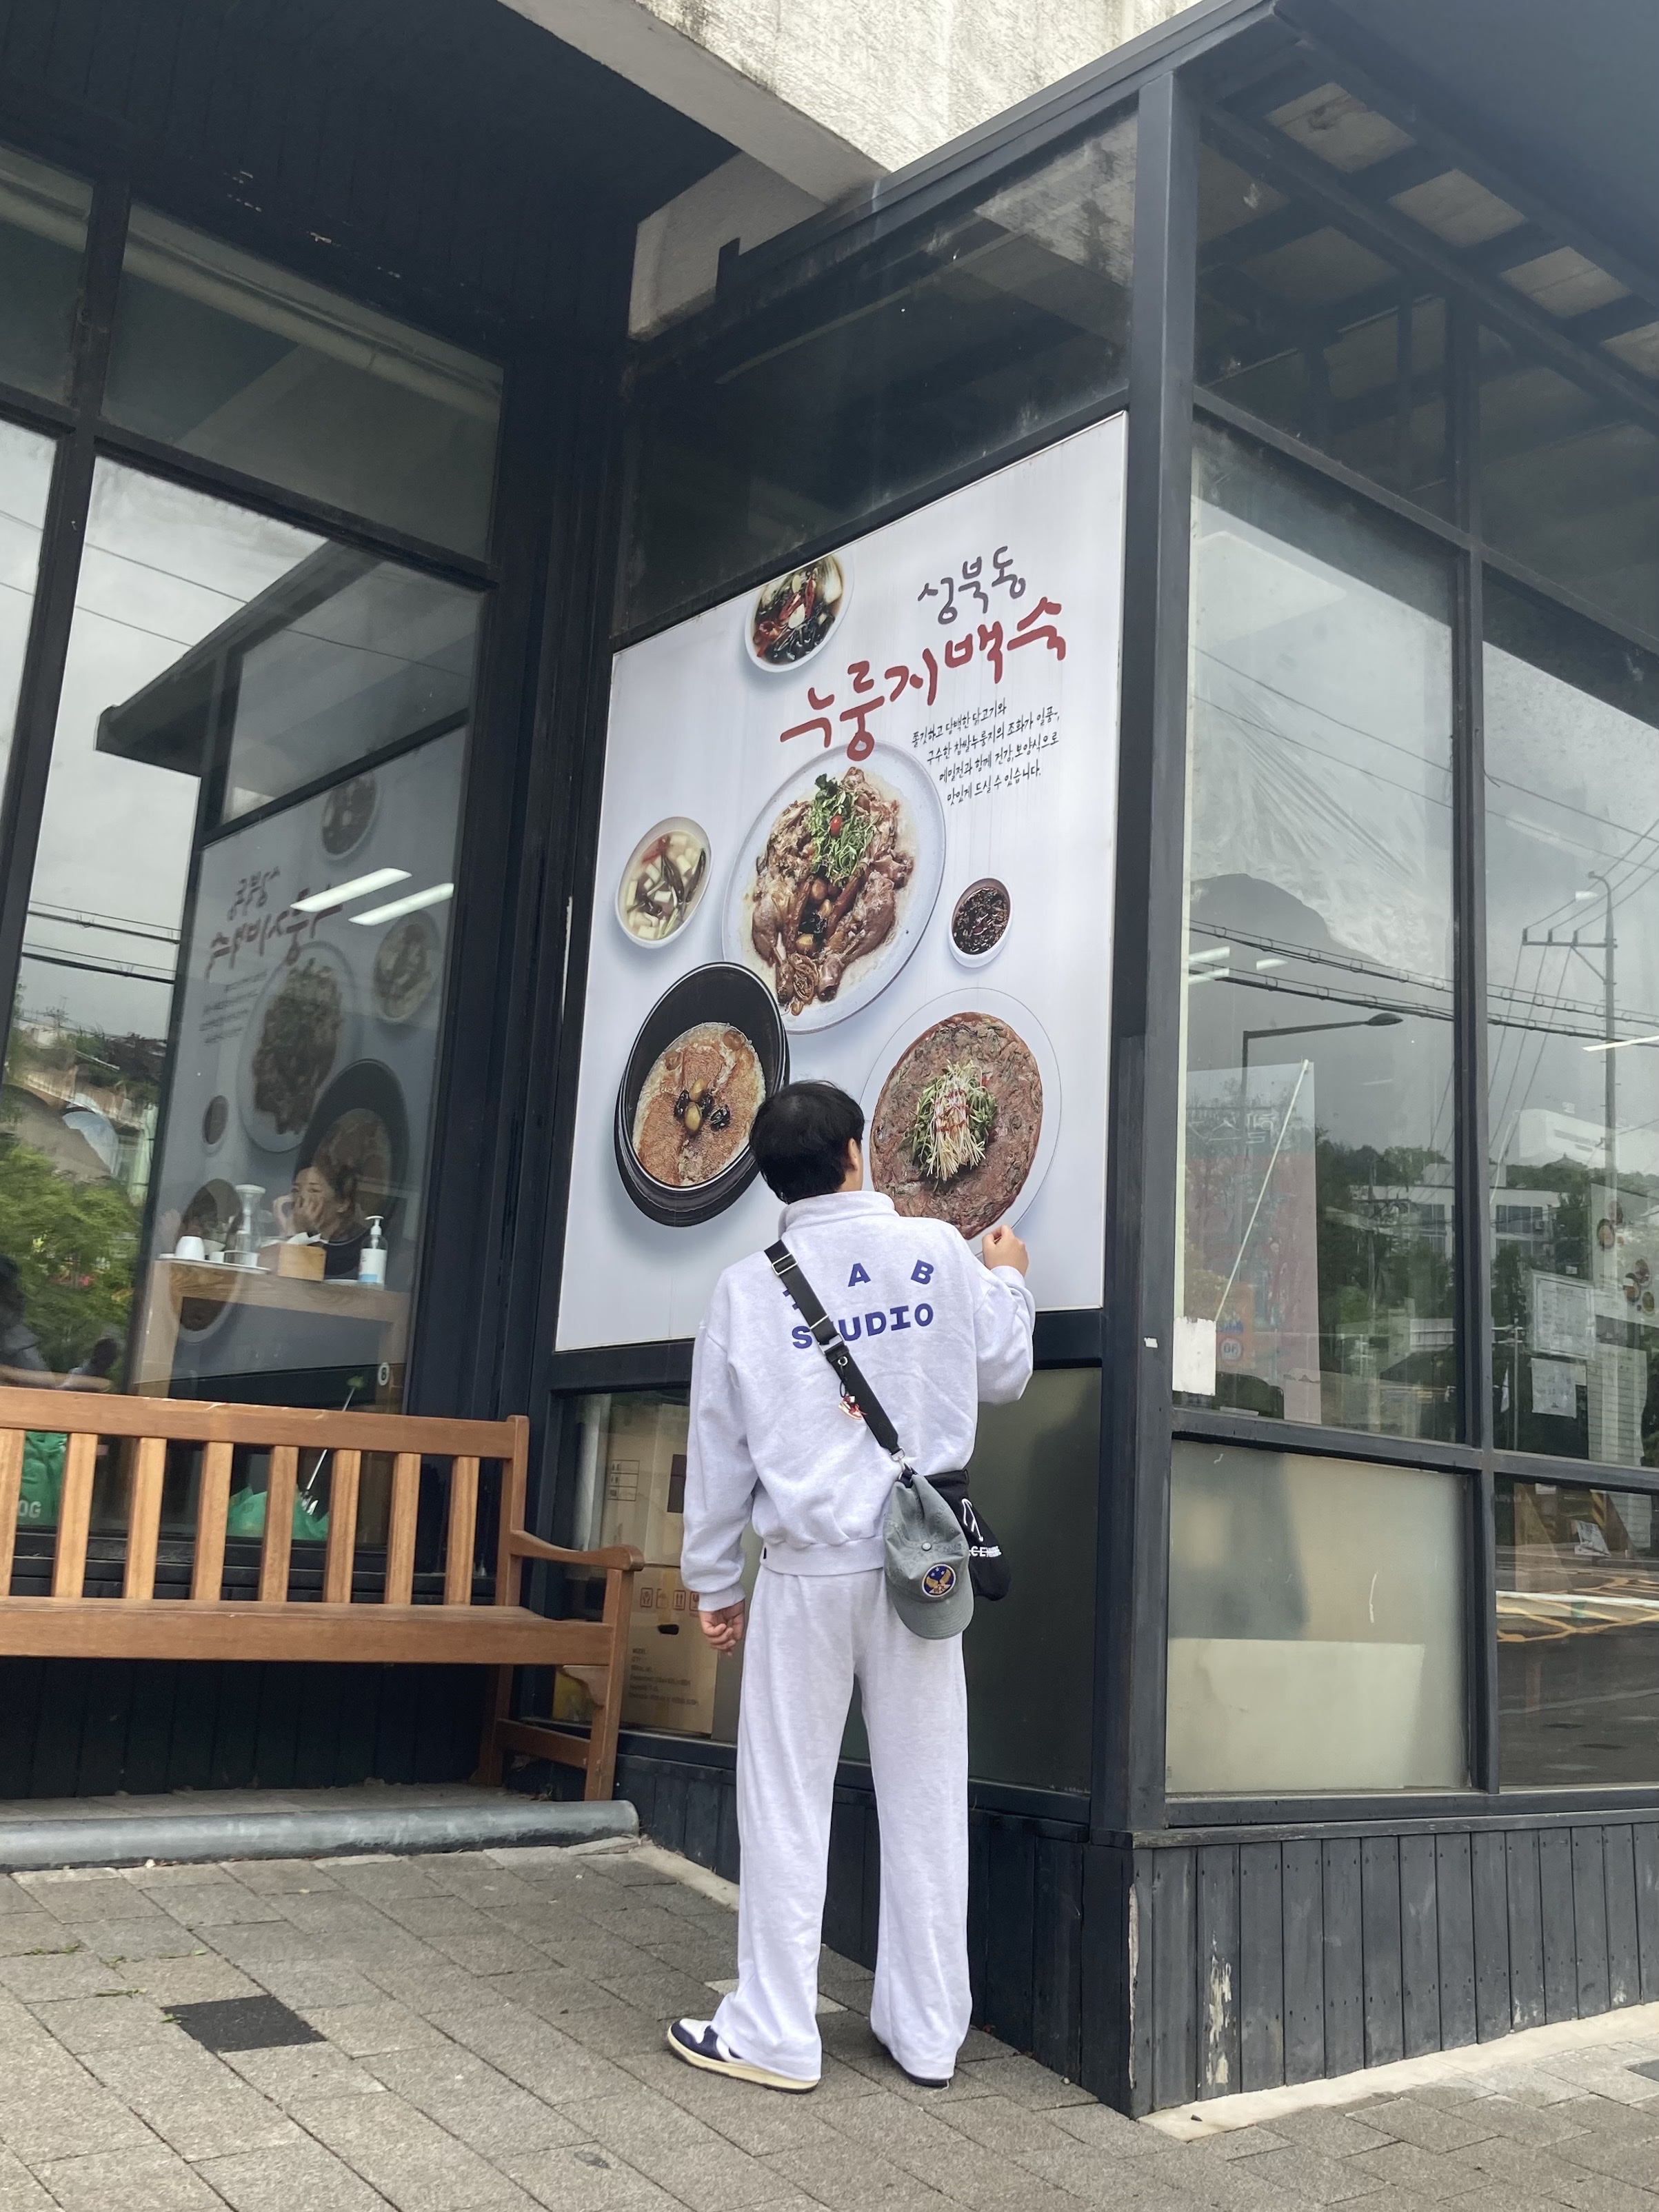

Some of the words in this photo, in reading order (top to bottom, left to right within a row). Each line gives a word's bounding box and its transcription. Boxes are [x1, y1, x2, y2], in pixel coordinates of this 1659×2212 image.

[918, 546, 1025, 624] 성북동
[781, 597, 1066, 762] 누룽지백숙
[927, 741, 952, 765] 구수한
[954, 721, 1005, 756] 찹쌀누룽지의
[1007, 711, 1034, 736] 조화가
[945, 711, 970, 735] 담백한
[972, 697, 1007, 726] 닭고기와
[939, 757, 973, 783] 메밀전과
[975, 750, 992, 772] 함께
[947, 782, 972, 806] 맛있게
[974, 775, 992, 796] 드실
[994, 774, 1003, 790] 수
[1004, 758, 1041, 787] 있습니다.
[792, 1303, 934, 1349] SUDIO
